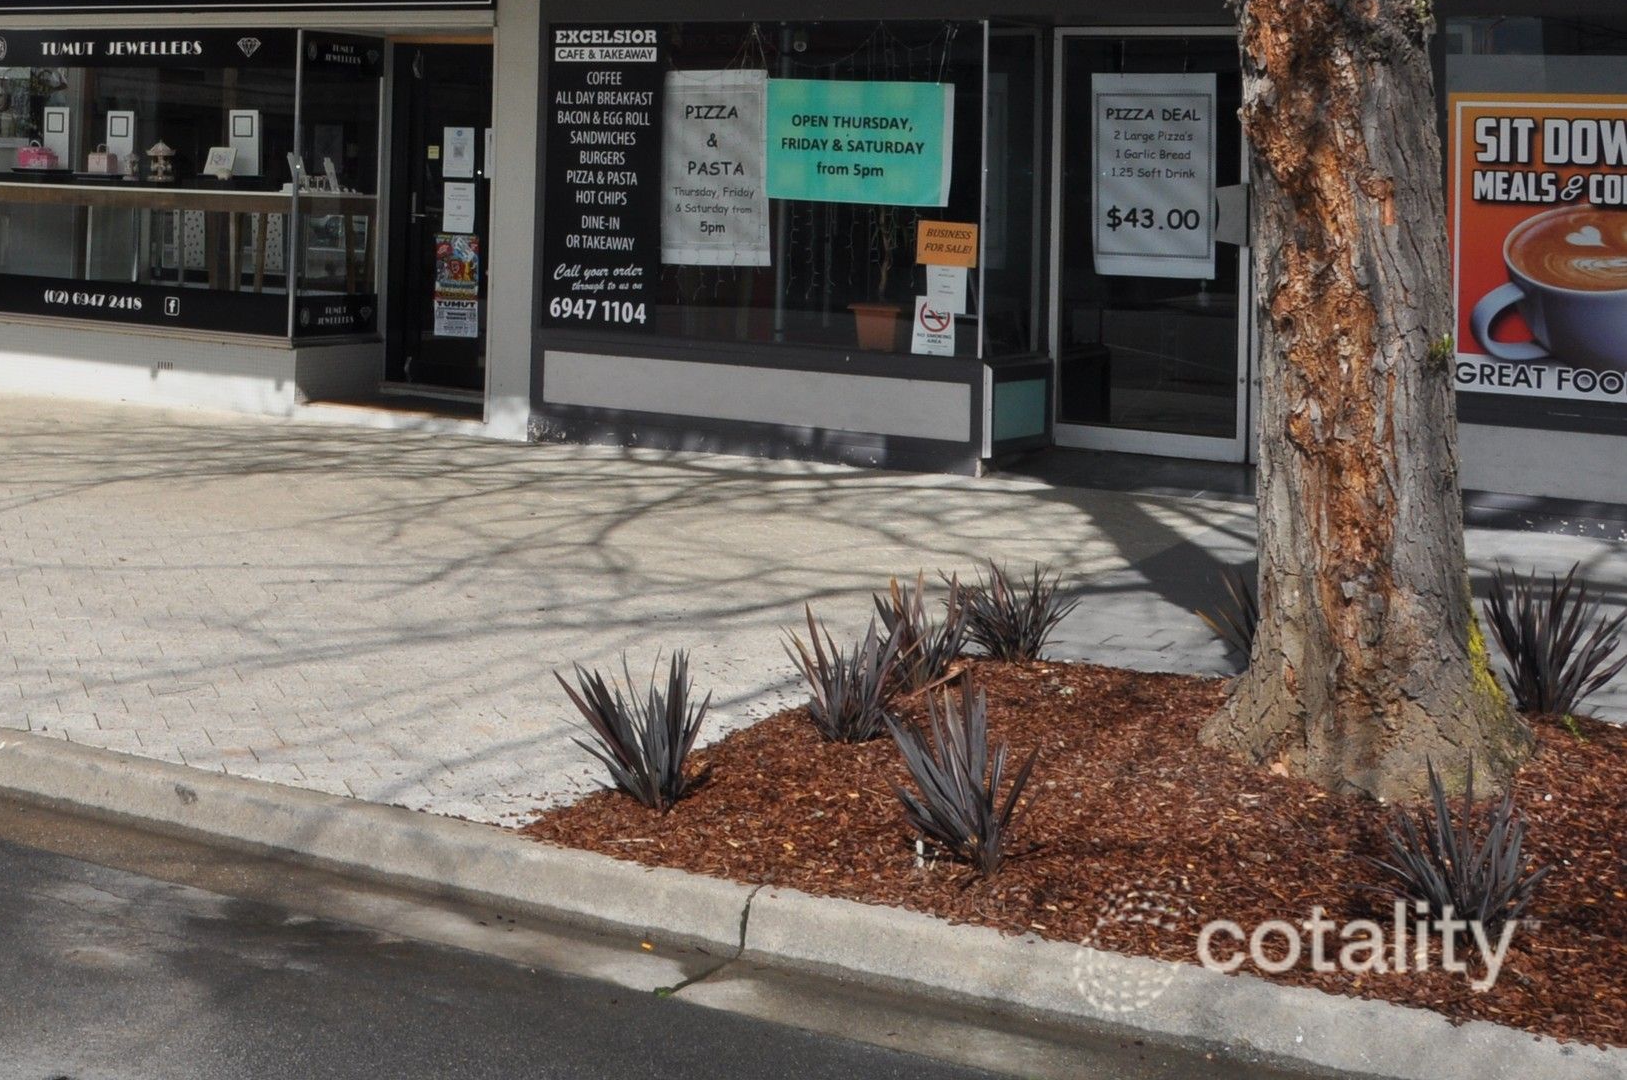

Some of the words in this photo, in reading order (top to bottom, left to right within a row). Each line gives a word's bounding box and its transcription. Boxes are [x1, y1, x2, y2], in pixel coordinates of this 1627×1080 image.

[555, 30, 657, 43] EXCELSIOR
[41, 42, 95, 55] TUMUT
[105, 40, 203, 56] JEWELLERS
[558, 49, 585, 59] CAFE
[588, 49, 596, 59] &
[599, 49, 654, 59] TAKEAWAY
[587, 71, 622, 85] COFFEE
[556, 91, 574, 105] ALL
[575, 91, 595, 105] DAY
[597, 92, 653, 105] BREAKFAST
[557, 111, 591, 124] BACON
[593, 111, 601, 125] &
[603, 111, 623, 125] EGG
[625, 112, 650, 126] ROLL
[685, 105, 738, 119] PIZZA
[1106, 108, 1154, 120] PIZZA
[1161, 108, 1201, 121] DEAL
[792, 114, 828, 127] OPEN
[833, 116, 913, 132] THURSDAY,
[570, 131, 636, 145] SANDWICHES
[706, 133, 717, 147] &
[1114, 131, 1120, 140] 2
[1124, 131, 1154, 143] Large
[1158, 131, 1193, 141] Pizza's
[1475, 117, 1535, 163] SIT
[1543, 118, 1627, 166] DOW
[781, 137, 828, 151] FRIDAY
[832, 139, 843, 152] &
[847, 139, 924, 154] SATURDAY
[579, 151, 625, 165] BURGERS
[1115, 149, 1121, 159] 1
[1124, 149, 1156, 159] Garlic
[1159, 149, 1191, 160] Bread
[688, 161, 744, 175] PASTA
[817, 161, 848, 175] from
[853, 163, 884, 179] 5pm
[1111, 168, 1134, 178] 1.25
[1137, 168, 1161, 178] Soft
[1165, 168, 1195, 179] Drink
[566, 170, 594, 184] PIZZA
[596, 171, 605, 184] &
[607, 171, 638, 185] PASTA
[673, 186, 716, 198] Thursday,
[723, 187, 754, 199] Friday
[1473, 170, 1556, 203] MEALS
[1560, 174, 1584, 201] &
[1589, 174, 1627, 205] CO
[576, 190, 596, 204] HOT
[598, 191, 627, 205] CHIPS
[675, 203, 681, 212] &
[685, 203, 729, 215] Saturday
[732, 205, 752, 213] from
[581, 215, 620, 230] DINE-IN
[1106, 205, 1200, 231] $43.00
[700, 221, 725, 235] 5pm
[926, 228, 972, 240] BUSINESS
[566, 234, 580, 248] OR
[582, 235, 635, 250] TAKEAWAY
[925, 243, 943, 253] FOR
[945, 243, 972, 254] SALE!
[554, 263, 581, 280] Call
[584, 267, 609, 280] your
[613, 264, 643, 276] order
[571, 280, 605, 293] through
[607, 281, 616, 290] to
[619, 282, 629, 290] us
[632, 282, 642, 290] on
[44, 289, 69, 305] (02)
[72, 292, 105, 307] 6947
[109, 294, 142, 310] 2418
[436, 300, 475, 308] TUMUT
[549, 297, 596, 320] 6947
[602, 300, 646, 324] 1104
[1455, 361, 1546, 389] GREAT
[1557, 368, 1627, 395] FOO
